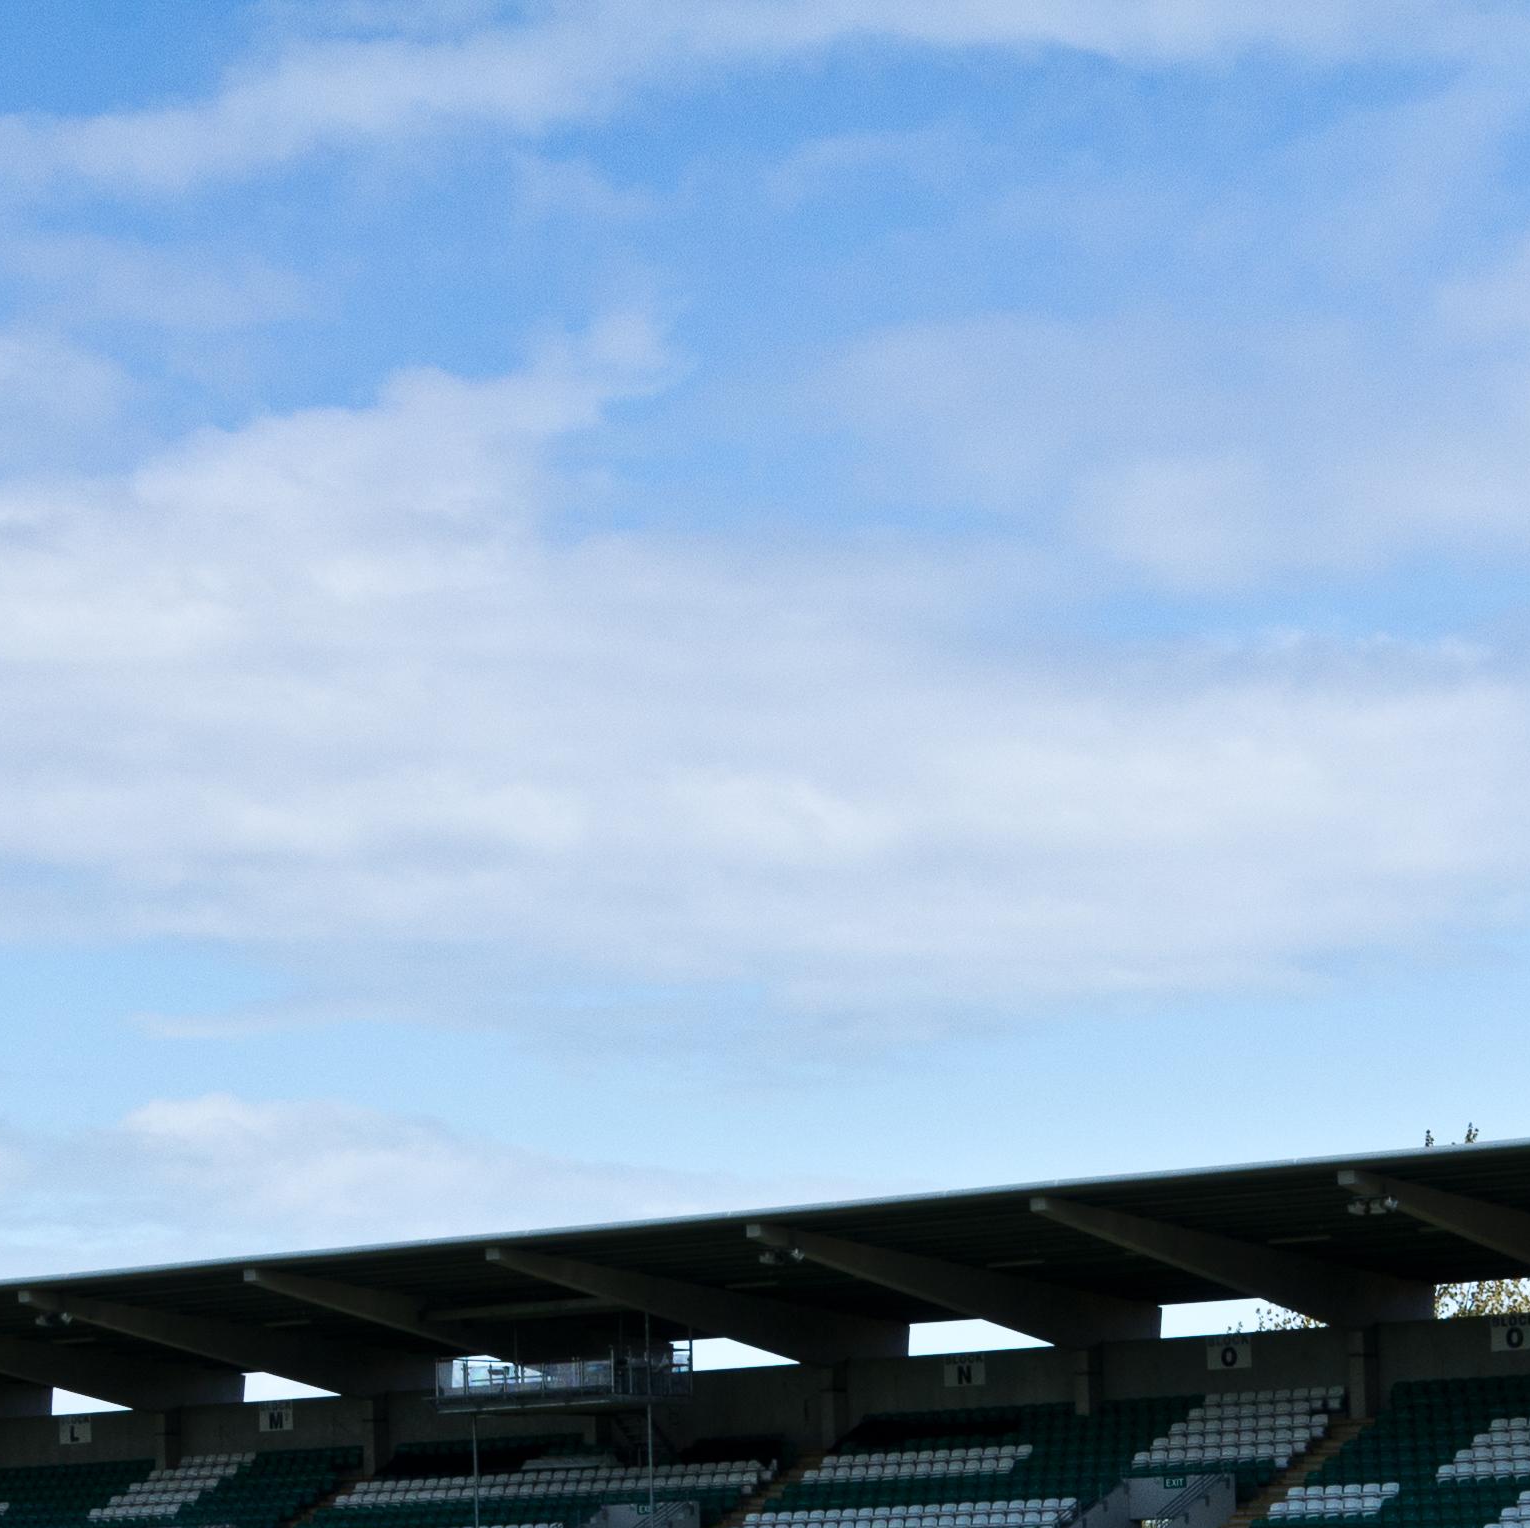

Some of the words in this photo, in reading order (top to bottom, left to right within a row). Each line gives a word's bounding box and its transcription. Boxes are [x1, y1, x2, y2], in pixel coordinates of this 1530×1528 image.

[957, 1365, 973, 1385] N
[269, 1412, 283, 1429] M
[70, 1425, 79, 1442] L
[1165, 1478, 1184, 1487] EXIT
